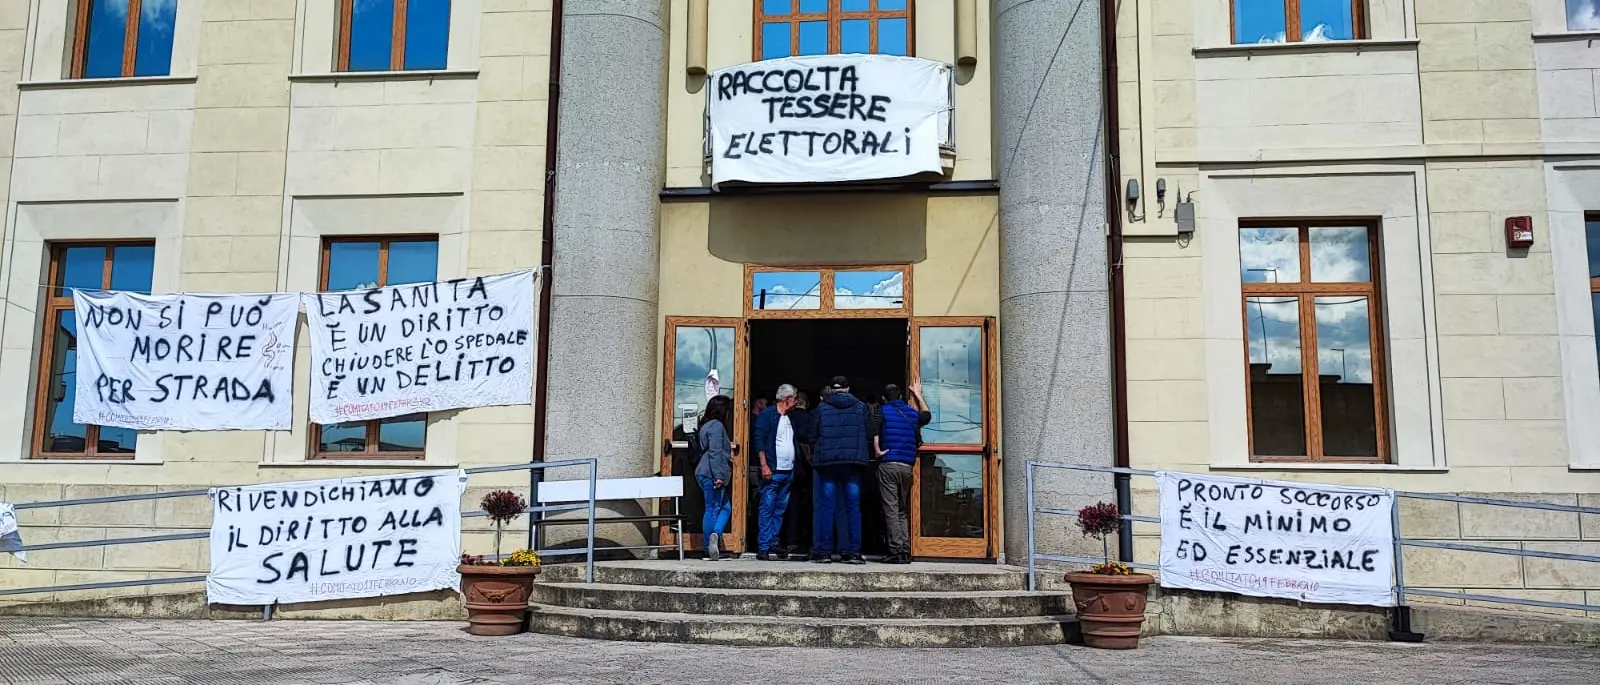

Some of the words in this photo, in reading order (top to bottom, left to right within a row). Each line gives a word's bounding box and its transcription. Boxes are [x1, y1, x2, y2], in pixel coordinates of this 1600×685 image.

[718, 65, 859, 101] RACCOLTA
[762, 92, 892, 124] TESSERE
[85, 304, 142, 331] NON
[358, 322, 386, 344] UN
[96, 372, 136, 404] PER
[150, 373, 276, 404] STRADA
[357, 376, 386, 395] UN
[1178, 478, 1263, 502] PRONTO
[1280, 488, 1380, 511] SOCCORSO
[378, 506, 443, 532] ALLA
[256, 538, 418, 584] SALUTE
[1176, 539, 1207, 562] ED
